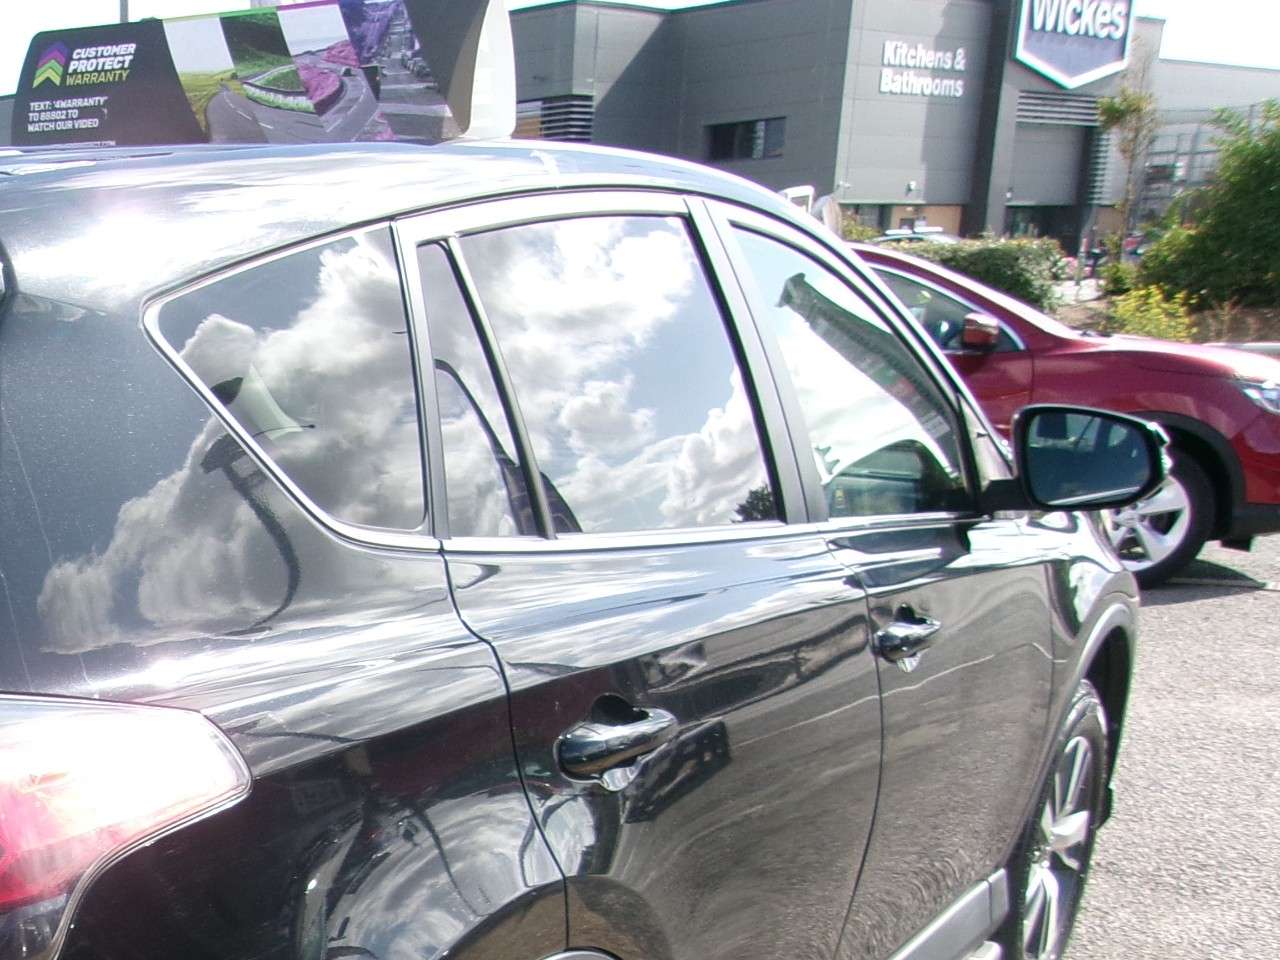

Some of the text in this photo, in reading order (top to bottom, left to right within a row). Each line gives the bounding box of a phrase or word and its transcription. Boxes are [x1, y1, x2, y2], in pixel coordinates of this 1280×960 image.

[1030, 0, 1127, 40] Wickes
[72, 43, 137, 60] CUSTOMER
[883, 40, 967, 71] Kitchens &
[68, 55, 133, 73] PROTECT
[66, 69, 130, 86] WARRANTY
[879, 69, 965, 98] Bathrooms
[28, 112, 39, 122] TO
[67, 109, 78, 118] TO
[27, 118, 99, 132] WATCH OUR VIDEO
